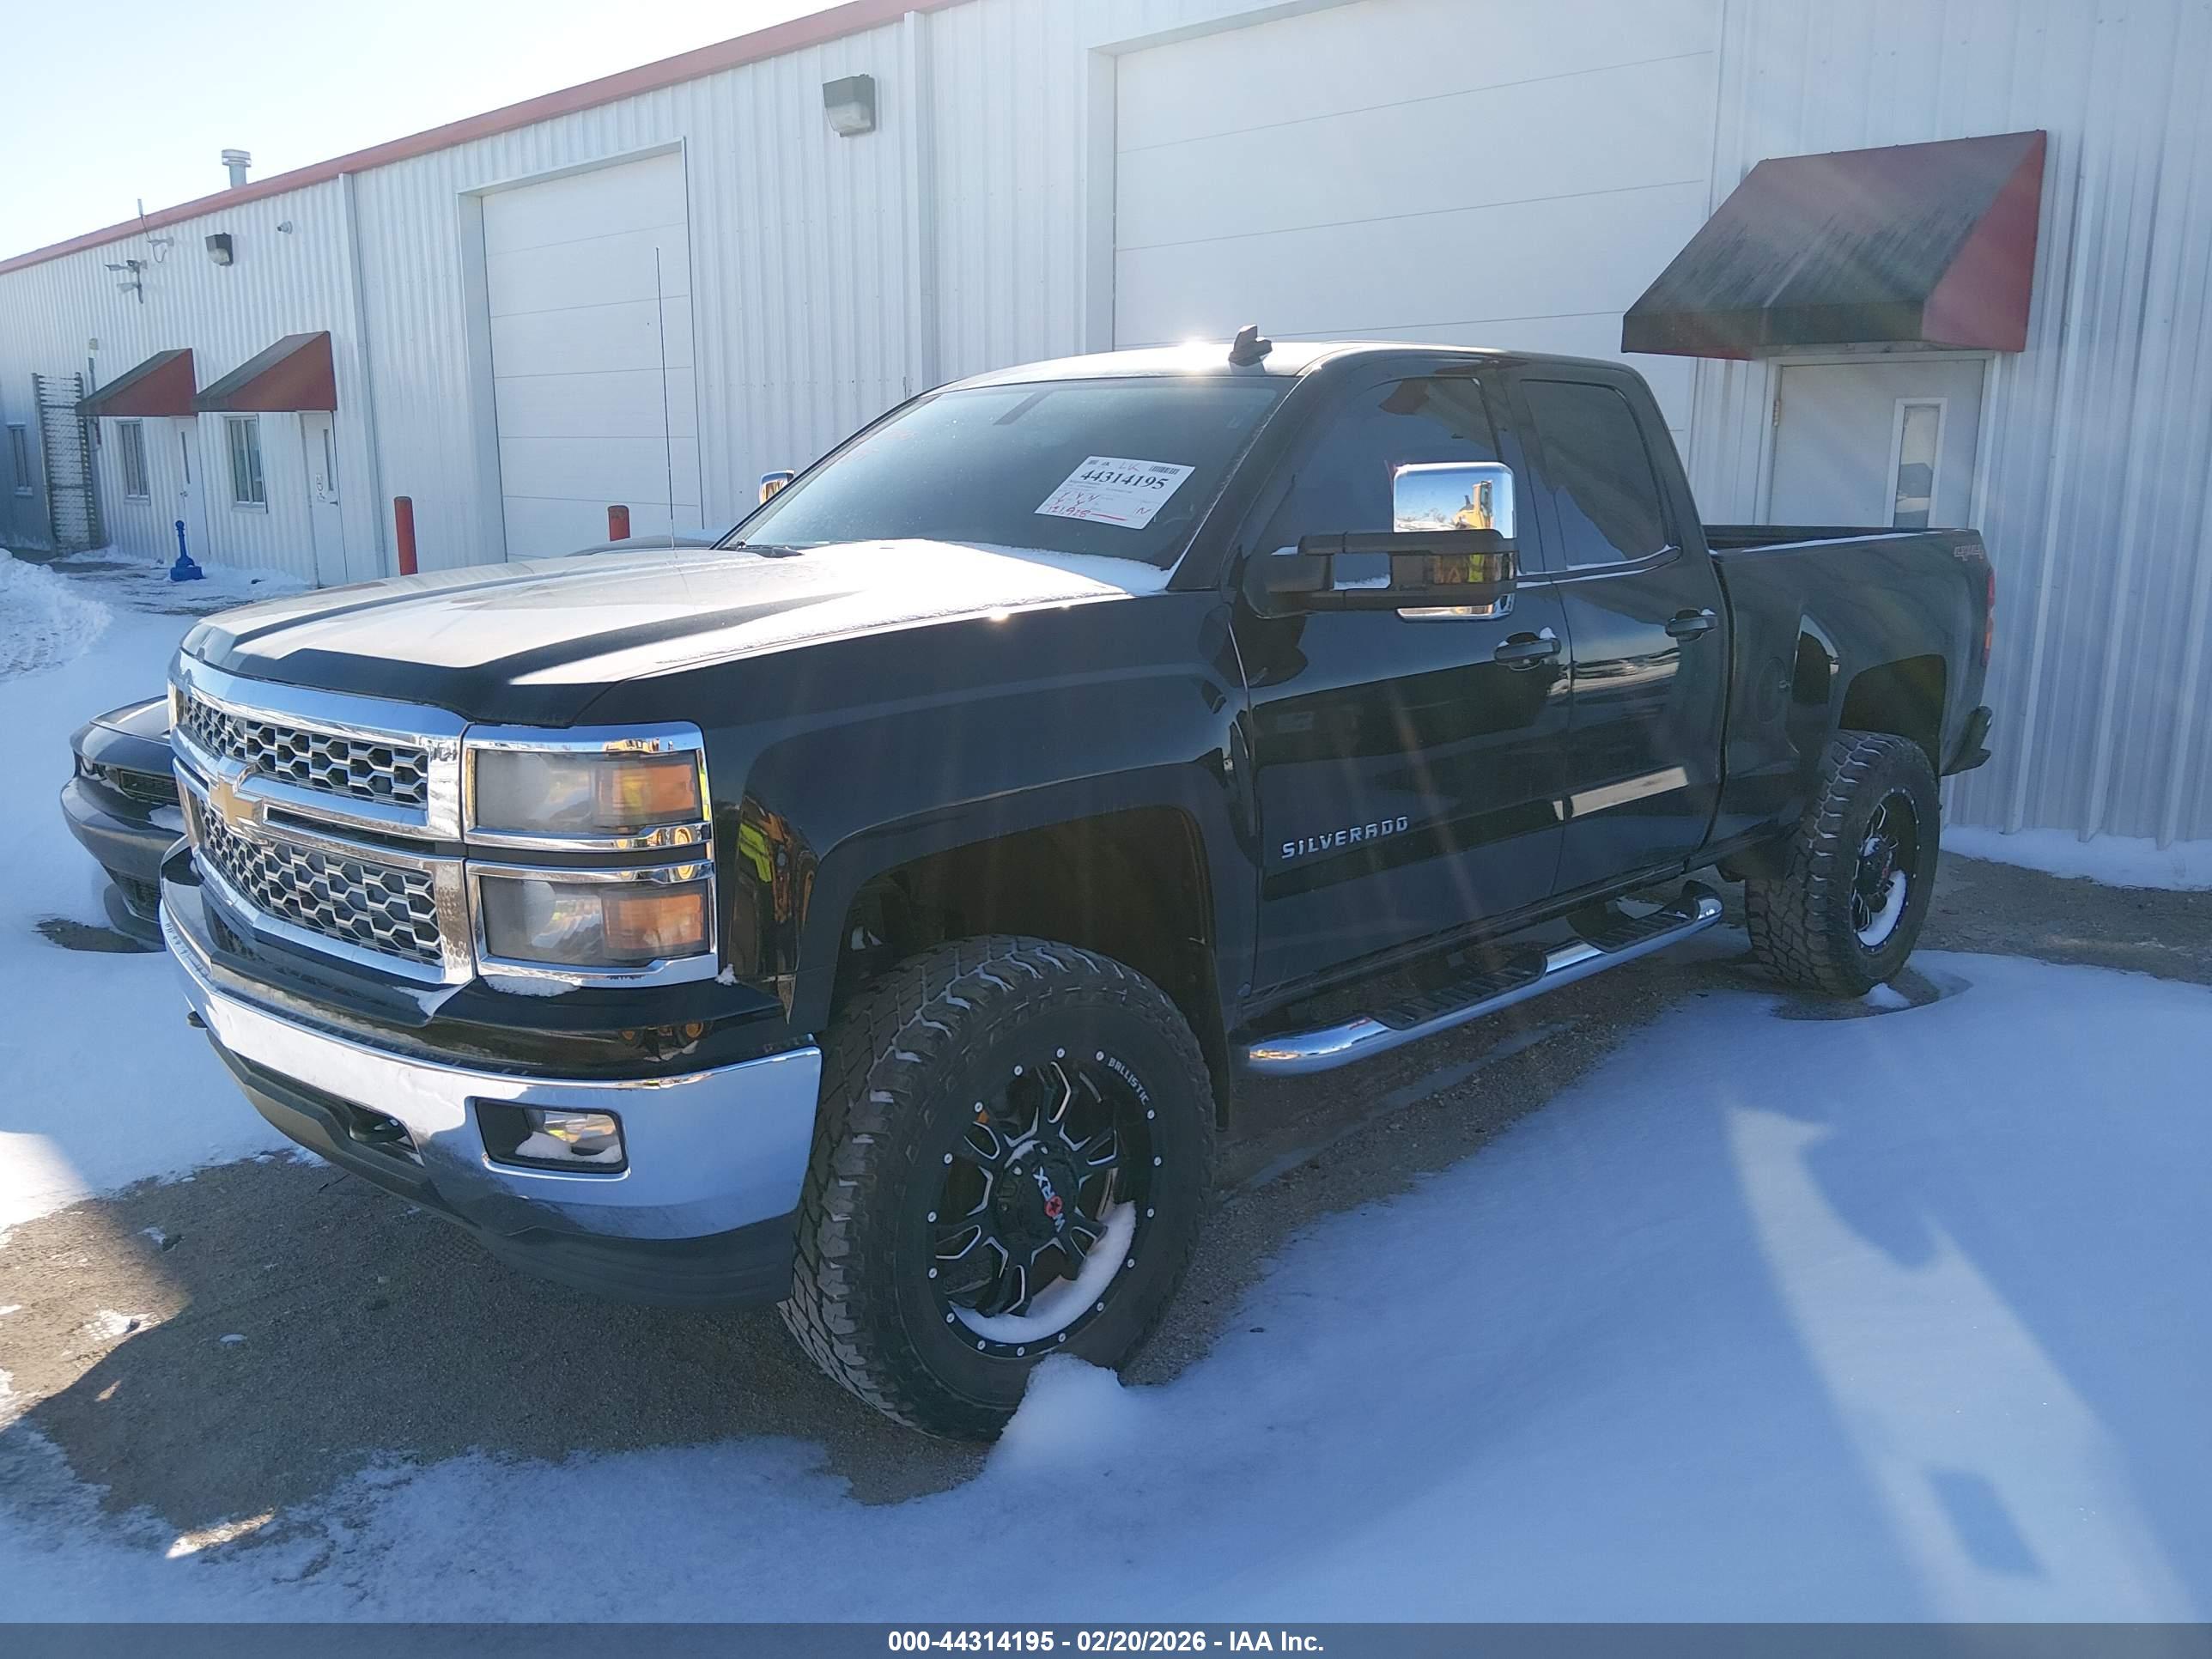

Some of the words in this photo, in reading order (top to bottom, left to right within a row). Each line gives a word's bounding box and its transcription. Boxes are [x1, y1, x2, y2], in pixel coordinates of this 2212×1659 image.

[1080, 470, 1169, 489] 44314195
[1281, 817, 1408, 859] SILVERADO
[1108, 1057, 1150, 1106] BALLISTIC
